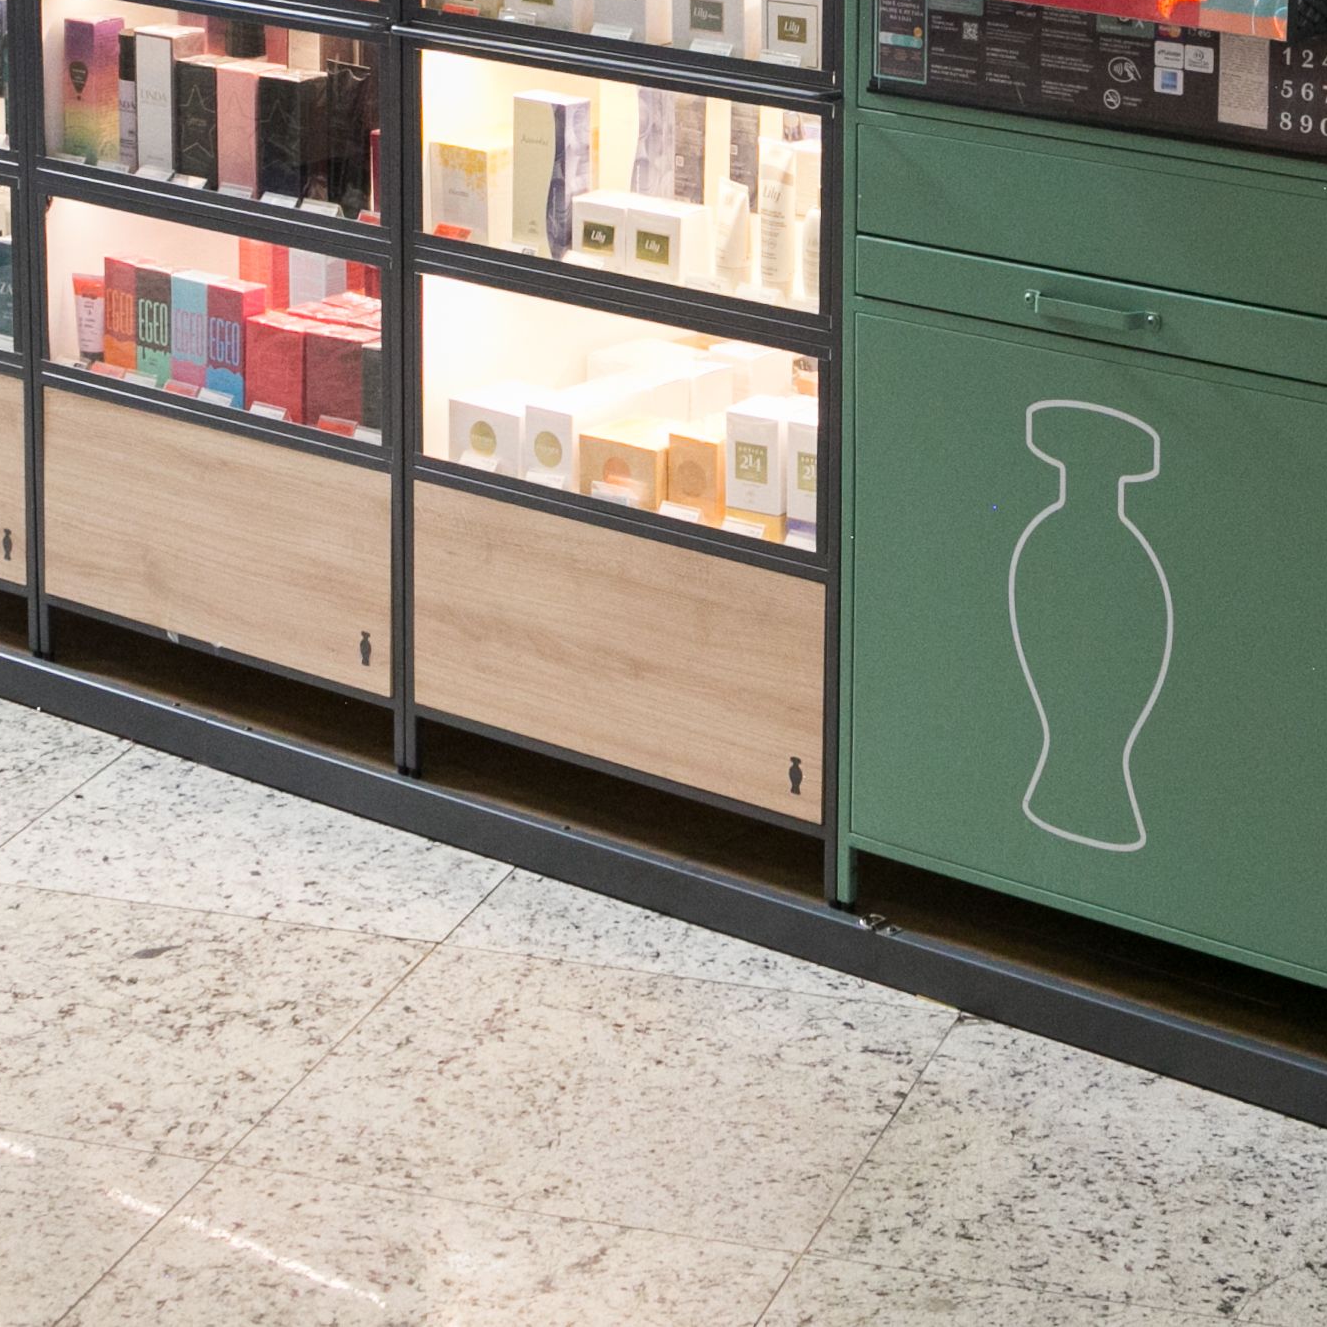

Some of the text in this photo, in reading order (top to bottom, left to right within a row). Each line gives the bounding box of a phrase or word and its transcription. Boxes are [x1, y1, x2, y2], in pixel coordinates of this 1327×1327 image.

[693, 6, 709, 21] Lily
[783, 20, 800, 34] Lily
[1282, 47, 1292, 66] 1
[1301, 49, 1314, 69] 2
[1280, 79, 1293, 99] 5
[1301, 82, 1314, 102] 6
[1279, 112, 1293, 131] 8
[1299, 114, 1313, 134] 9
[591, 229, 606, 244] Lily
[645, 238, 661, 253] Lily
[106, 287, 133, 336] EGEO
[138, 298, 169, 347] EGEO
[174, 308, 205, 357] EGEO
[208, 316, 240, 366] EGEO
[739, 453, 762, 472] 214
